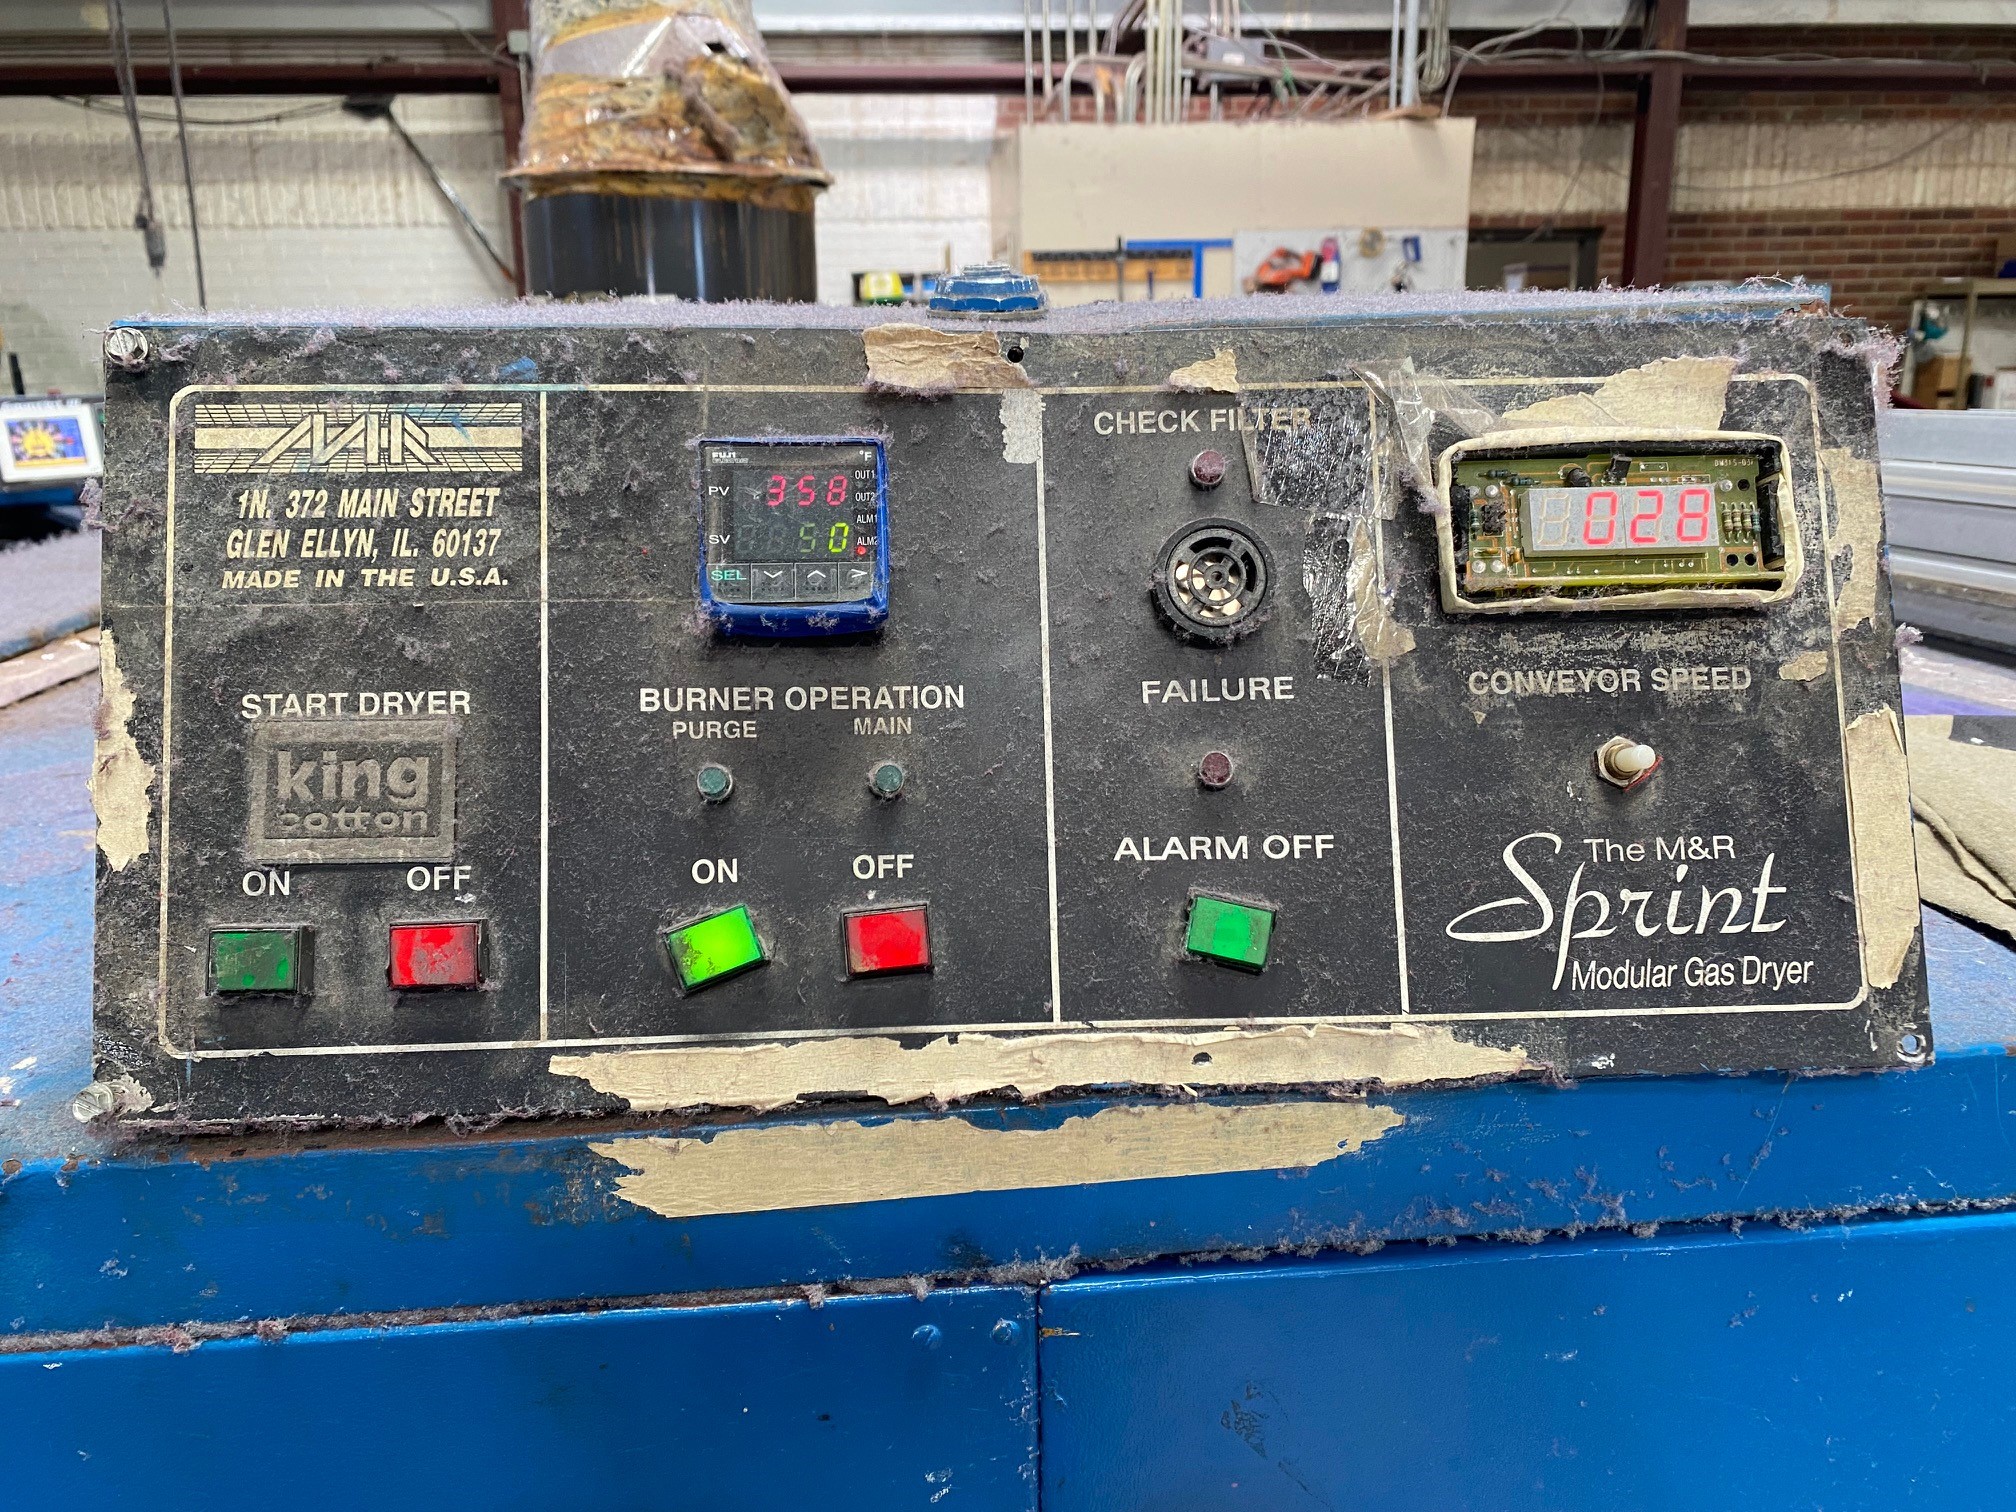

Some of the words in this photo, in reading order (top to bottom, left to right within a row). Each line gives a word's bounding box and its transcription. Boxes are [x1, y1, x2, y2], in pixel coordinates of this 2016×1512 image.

[1094, 409, 1201, 436] CHECK
[1210, 407, 1312, 432] FILTER
[854, 469, 875, 480] OUT1
[238, 489, 271, 518] 1N.
[286, 488, 328, 518] 372
[337, 489, 399, 518] MAIN
[409, 487, 501, 518] STREET
[708, 486, 730, 496] PV
[767, 475, 848, 507] 358
[855, 492, 876, 502] OUT2
[856, 514, 877, 524] ALM1
[1582, 489, 1711, 546] 028
[226, 529, 290, 559] GLEN
[300, 528, 378, 563] ELLYN,
[390, 528, 419, 557] IL.
[431, 528, 502, 557] 60137
[708, 534, 731, 545] SV
[221, 570, 299, 589] MADE
[315, 569, 344, 588] IN
[361, 568, 416, 587] THE
[430, 567, 509, 586] U.S.A.
[711, 569, 747, 581] SEL
[1141, 675, 1295, 704] FAILURE
[1468, 668, 1641, 695] CONVEYOR
[1651, 666, 1751, 691] SPEED
[241, 692, 348, 719] START
[359, 690, 471, 716] DRYER
[639, 686, 774, 712] BURNER
[784, 684, 965, 710] OPERATION
[672, 720, 757, 739] PURGE
[853, 717, 912, 735] MAIN
[277, 750, 430, 808] king
[279, 806, 428, 834] cotton
[1113, 835, 1249, 861] ALARM
[1262, 834, 1335, 859] OFF
[1583, 837, 1645, 863] The
[1656, 834, 1736, 861] M&R
[406, 865, 472, 891] OFF
[691, 858, 739, 885] ON
[852, 853, 915, 880] OFF
[241, 870, 290, 896] ON
[1445, 831, 1787, 991] Sprint
[1571, 958, 1678, 991] Modular
[1683, 957, 1735, 988] Gas
[1742, 954, 1815, 992] Dryer
